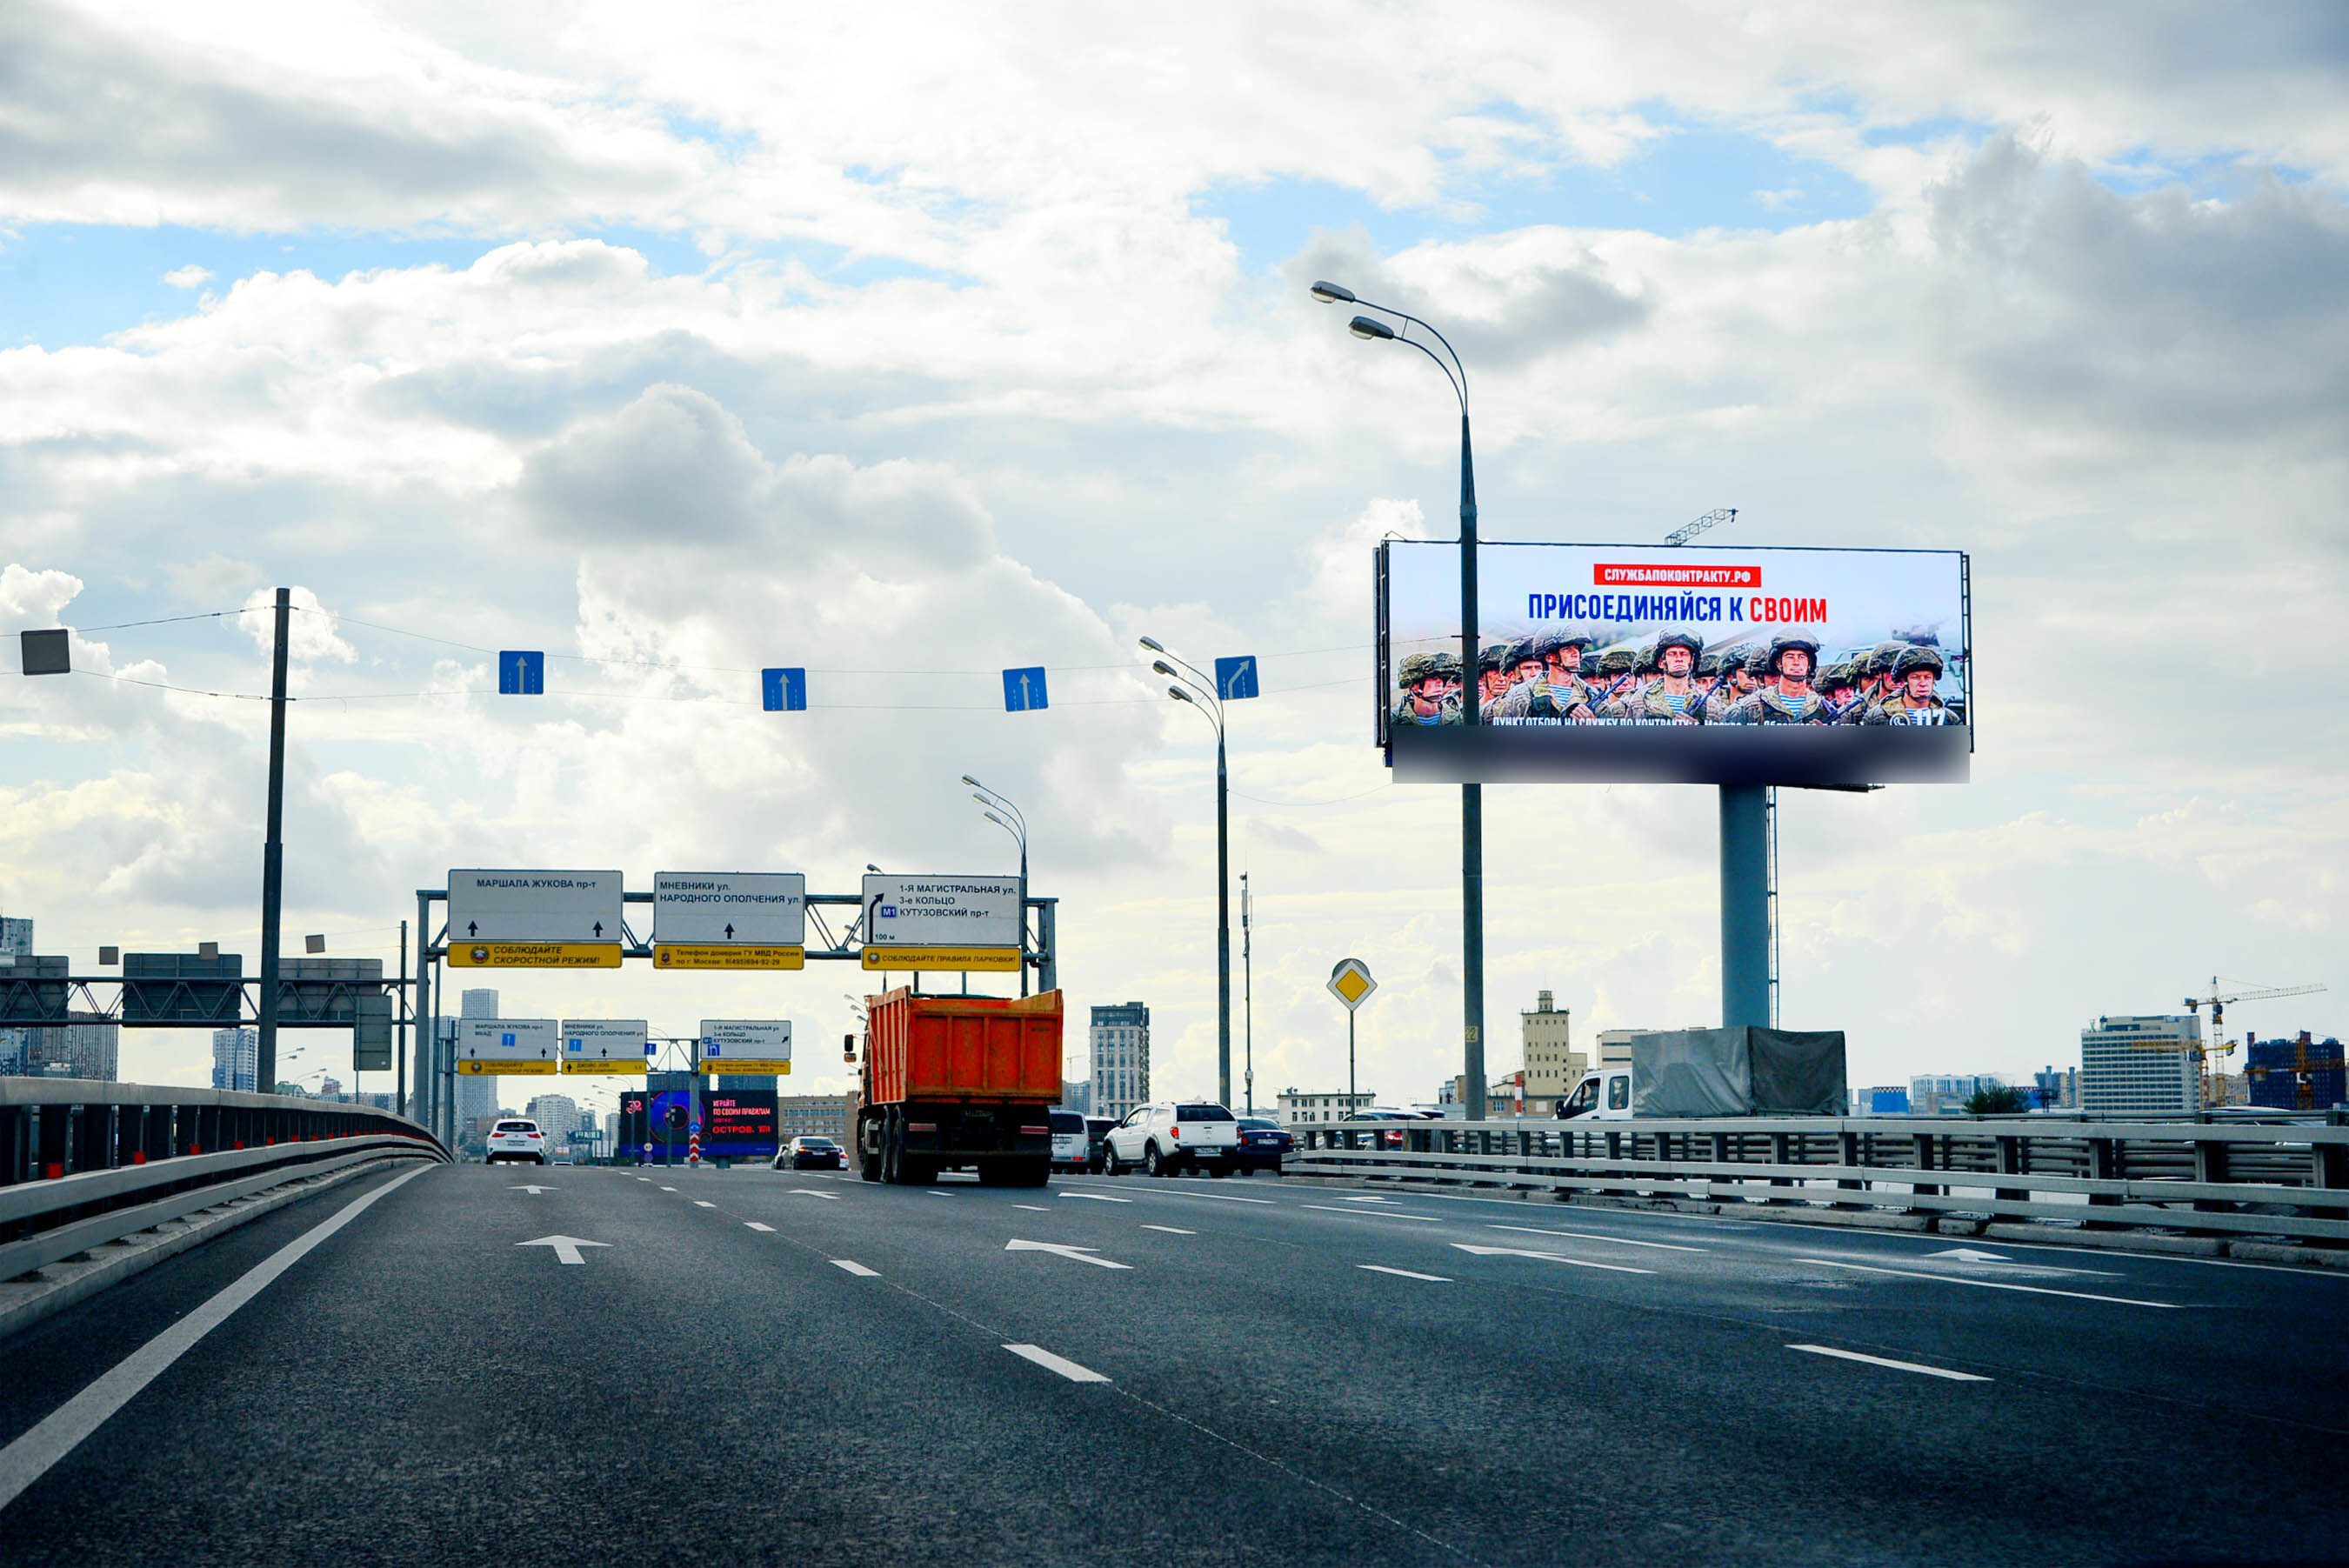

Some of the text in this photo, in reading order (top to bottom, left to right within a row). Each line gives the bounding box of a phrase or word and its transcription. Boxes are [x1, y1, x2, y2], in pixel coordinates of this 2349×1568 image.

[1604, 568, 1752, 584] СЛУЖБАПОКОНТРАКТУ.РФ
[1528, 590, 1827, 623] ПРИСОЕДИНЯЙСЯ К СВОИМ
[476, 878, 597, 890] МАРШАЛА ЖУКОВА пр-т
[659, 882, 731, 892] МНЕВНИКИ ул.
[917, 884, 1000, 894] МАГИСТРАЛЬНАЯ
[1002, 887, 1017, 896] ул.
[659, 894, 802, 905] НАРОДНОГО ОПОЛЧЕНИЯ ул.
[915, 897, 956, 906] КОЛЬЦО
[899, 907, 990, 918] КУТУЗОВСКИЙ пр-т
[493, 944, 564, 954] СОБЛЮДАЙТЕ
[493, 955, 600, 964] СКОРОСТНОЙ РЕЖИМ!
